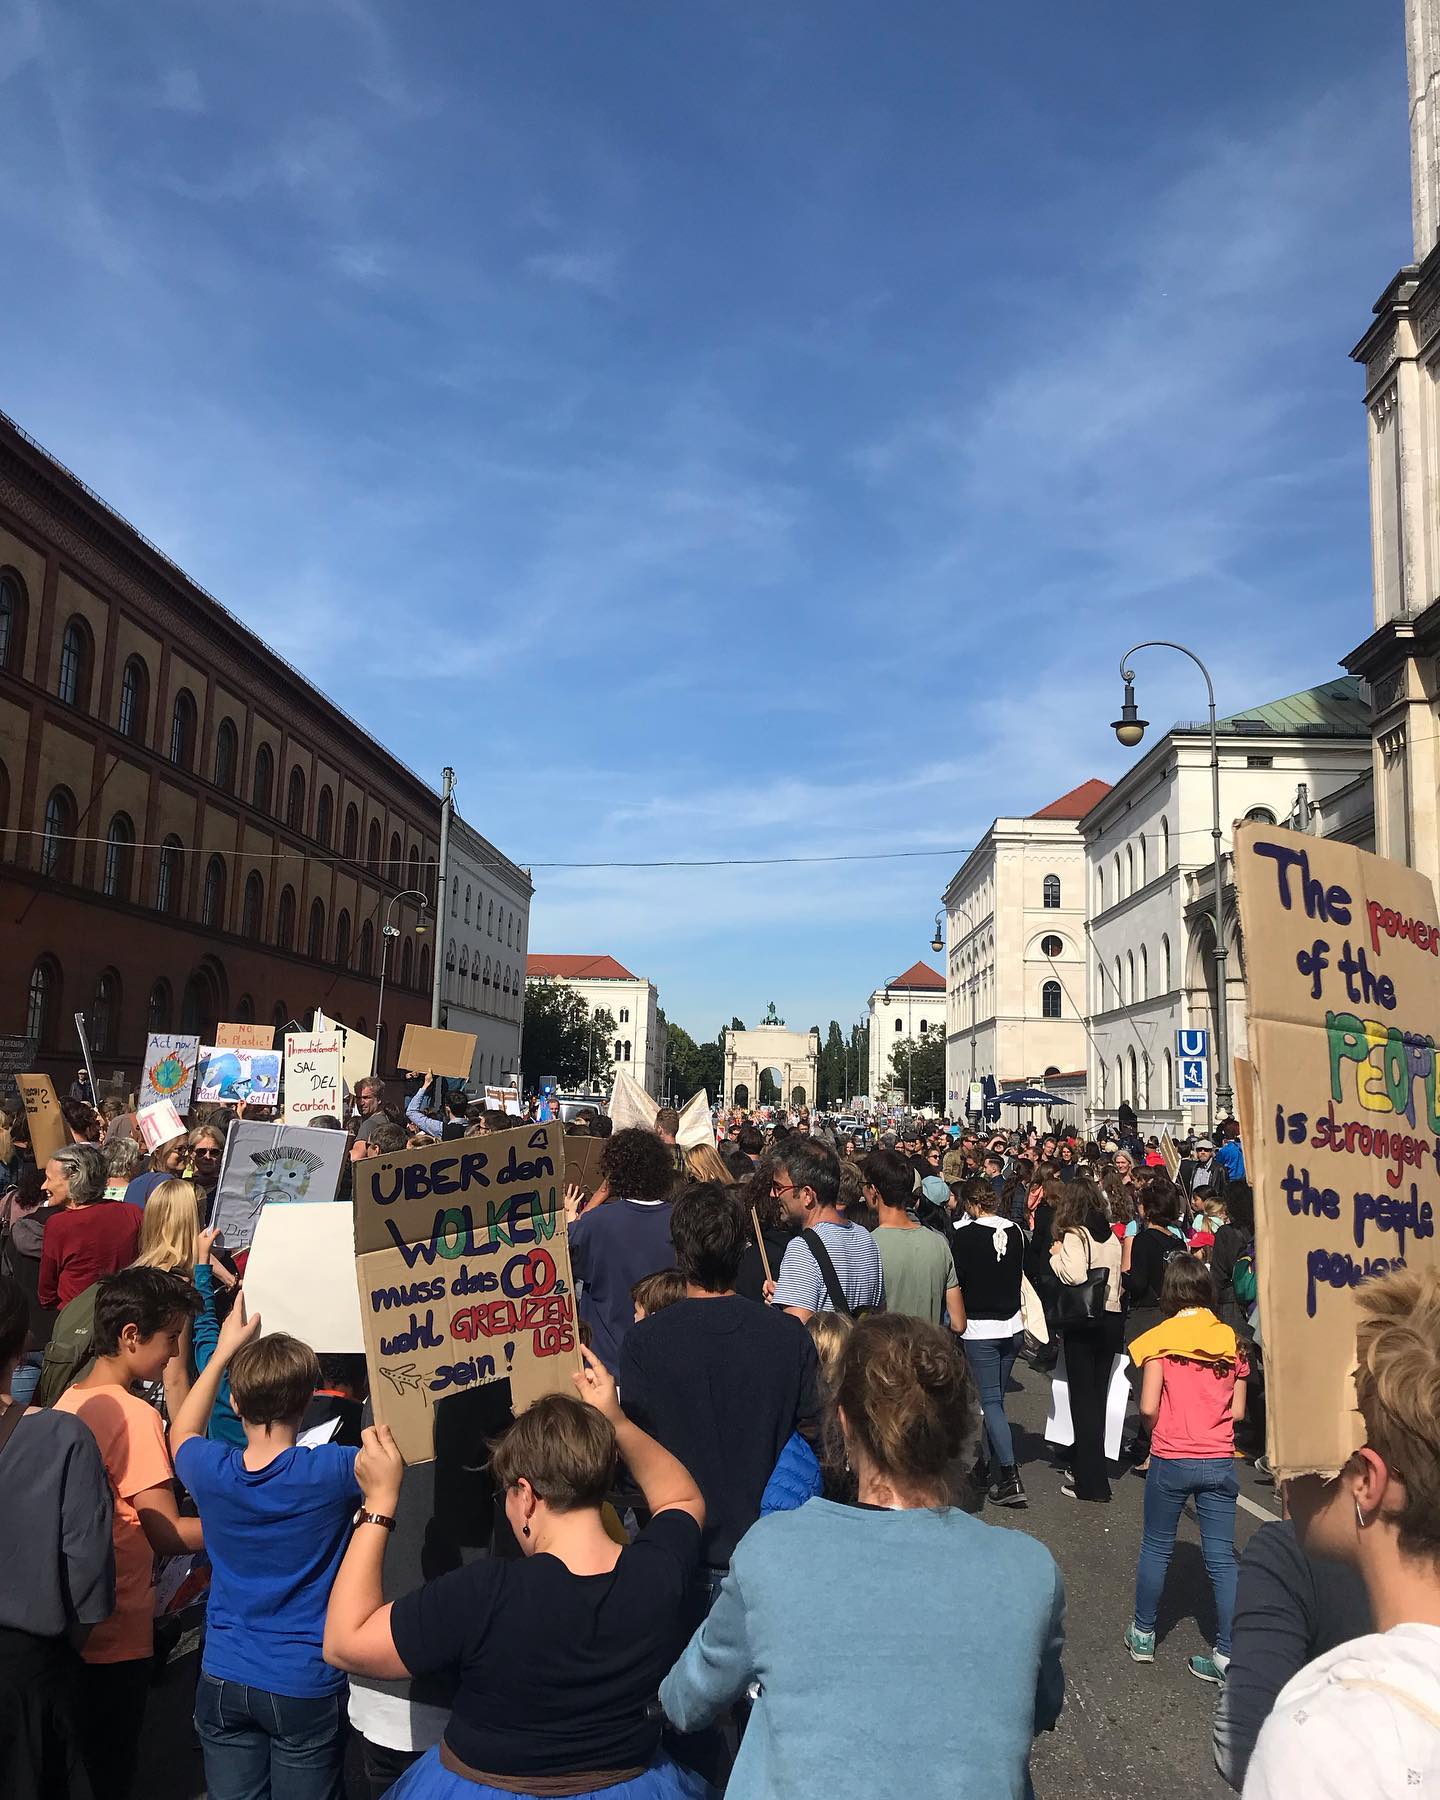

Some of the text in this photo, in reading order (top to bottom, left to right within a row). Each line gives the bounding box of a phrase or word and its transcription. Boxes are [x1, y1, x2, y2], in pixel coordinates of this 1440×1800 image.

[1253, 842, 1440, 957] The power
[1296, 939, 1397, 1010] of the
[150, 1036, 171, 1049] Act
[293, 1061, 317, 1074] SAL
[1181, 1031, 1203, 1056] U
[310, 1074, 337, 1091] DEL
[1275, 1103, 1307, 1144] is
[1311, 1100, 1430, 1188] stronger
[371, 1146, 554, 1205] ÜBER den
[1280, 1164, 1434, 1255] the people
[371, 1277, 446, 1313] muss
[451, 1264, 499, 1296] das
[380, 1295, 574, 1356] wohl GRENZEN
[533, 1324, 575, 1357] LOS
